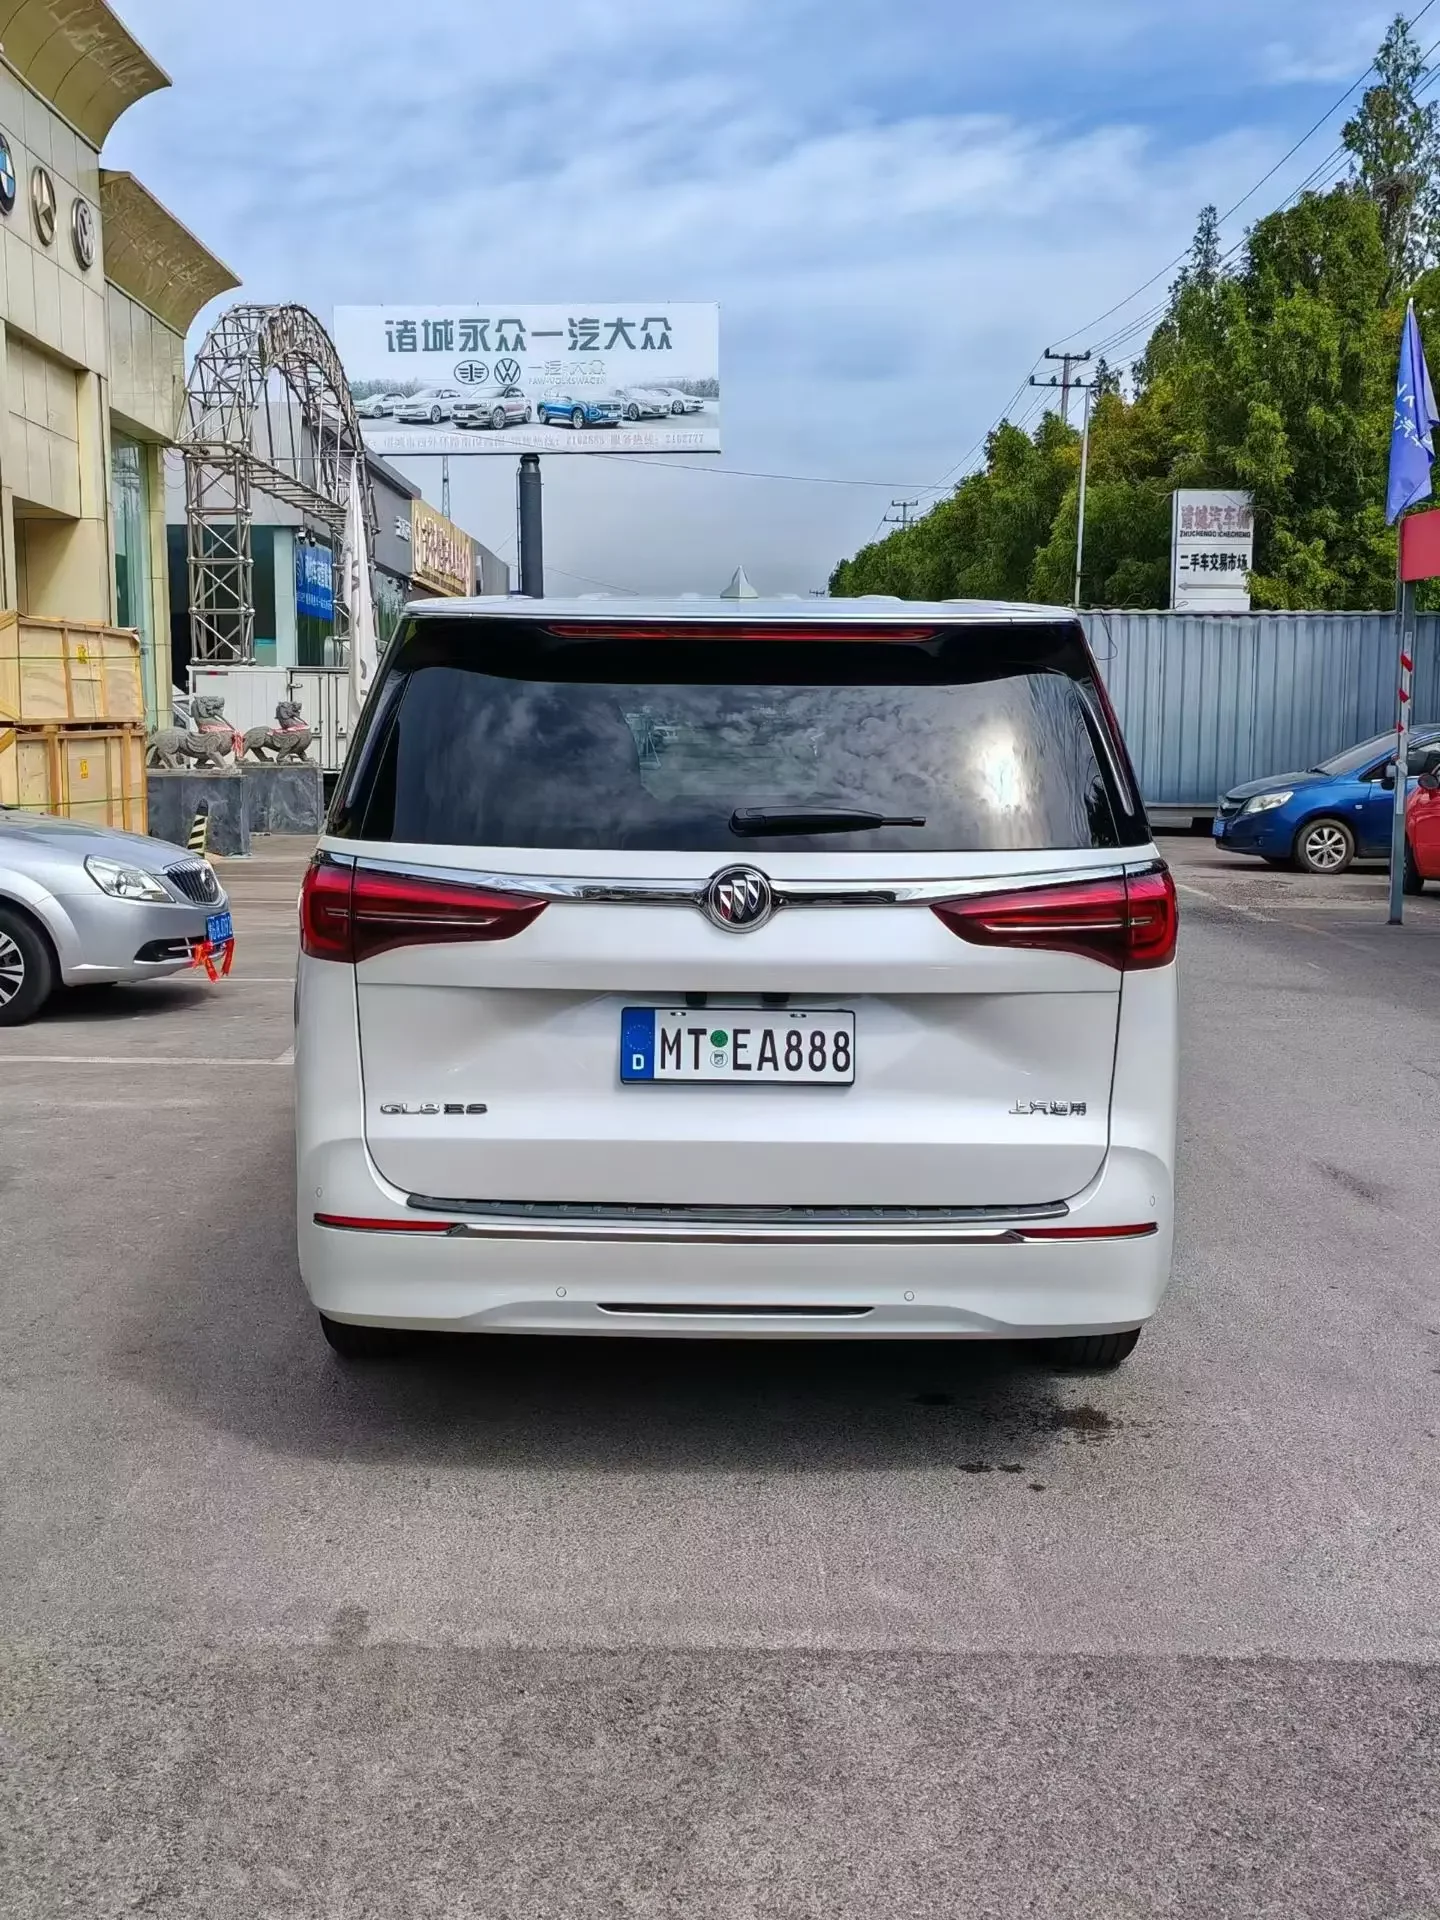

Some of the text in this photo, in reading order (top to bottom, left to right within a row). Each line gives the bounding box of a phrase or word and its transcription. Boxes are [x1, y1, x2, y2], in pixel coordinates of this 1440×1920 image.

[384, 317, 673, 353] 诸城永众一汽大众
[1179, 553, 1248, 572] 二手车交易市场
[660, 1027, 851, 1073] MT EA888
[632, 1053, 645, 1070] D
[380, 1103, 440, 1115] GL8
[1008, 1099, 1087, 1116] 上汽通用
